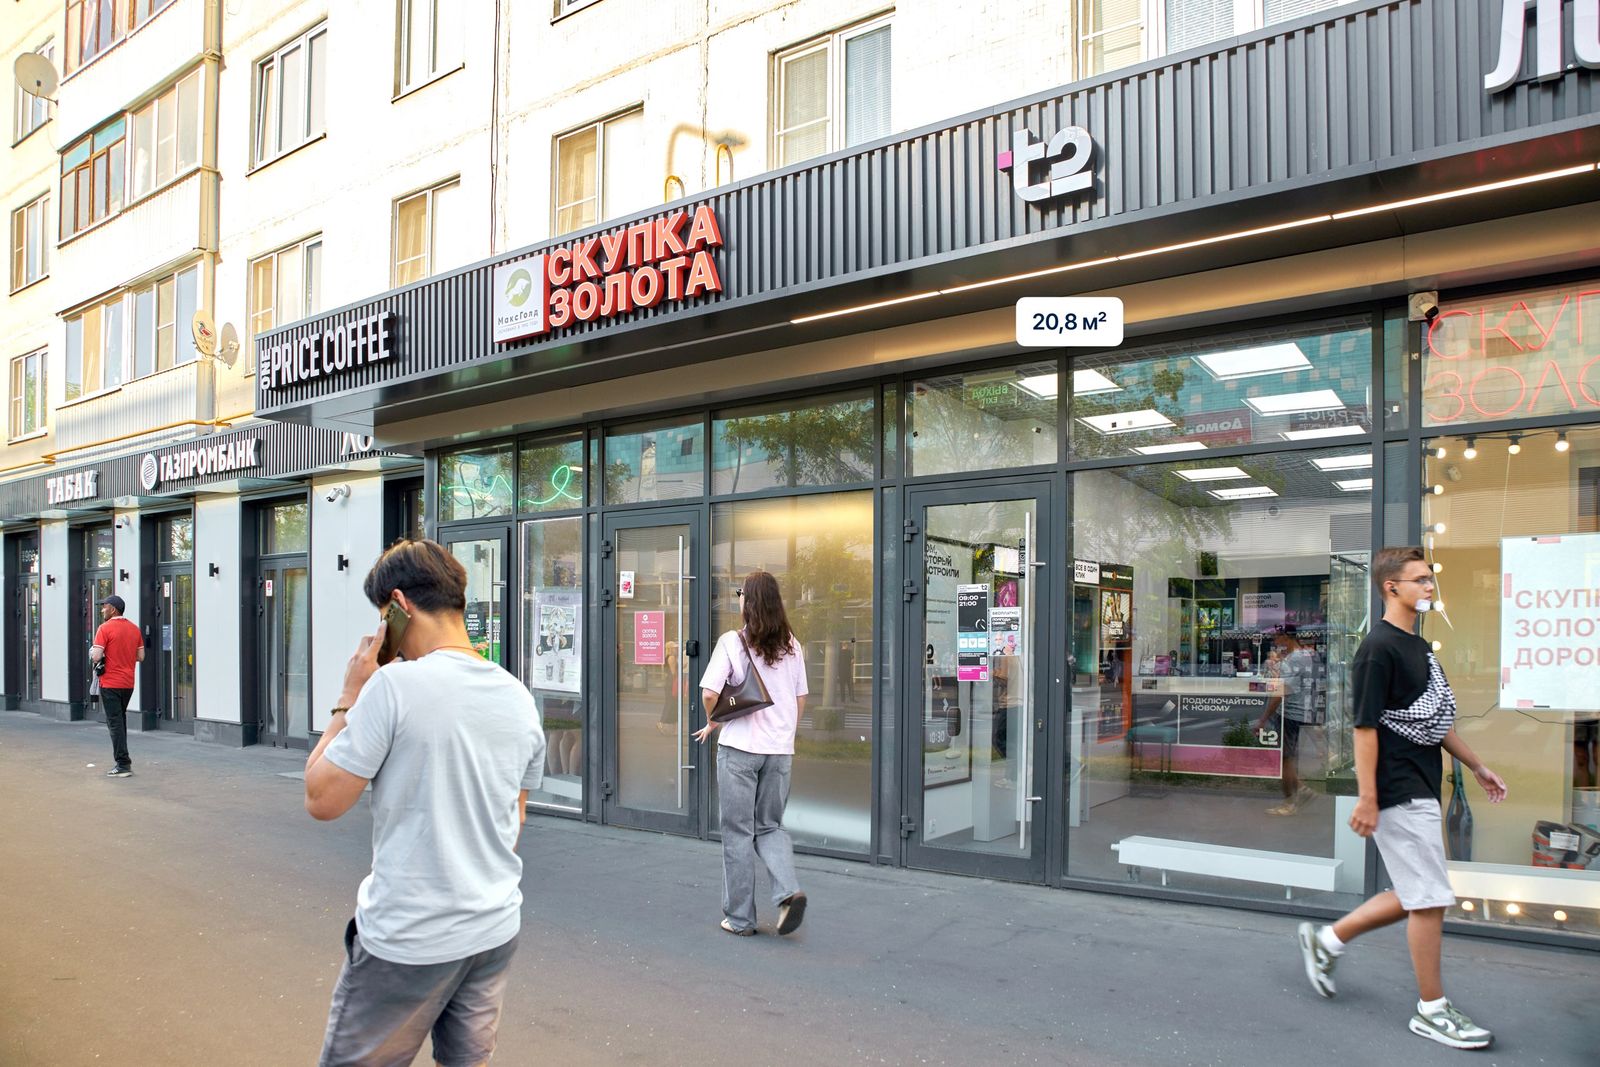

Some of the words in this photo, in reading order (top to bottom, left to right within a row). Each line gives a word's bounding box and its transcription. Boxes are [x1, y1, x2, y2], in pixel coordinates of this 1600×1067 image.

[998, 126, 1093, 202] t2
[548, 205, 721, 286] СКУПКА
[549, 250, 721, 327] ЗОЛОТА
[261, 348, 271, 390] ONE
[271, 332, 320, 388] PRICE
[322, 311, 390, 374] COFFEE
[160, 438, 258, 482] ГАЗПРОМБАНК
[47, 470, 97, 504] ТАБАК
[1515, 589, 1600, 609] СКУП
[1514, 618, 1600, 638] ЗОЛО
[1514, 647, 1600, 669] ДОРО
[1182, 697, 1264, 706] ПОДКЛЮЧАЙТЕСЬ
[1191, 704, 1231, 712] НОВОМУ
